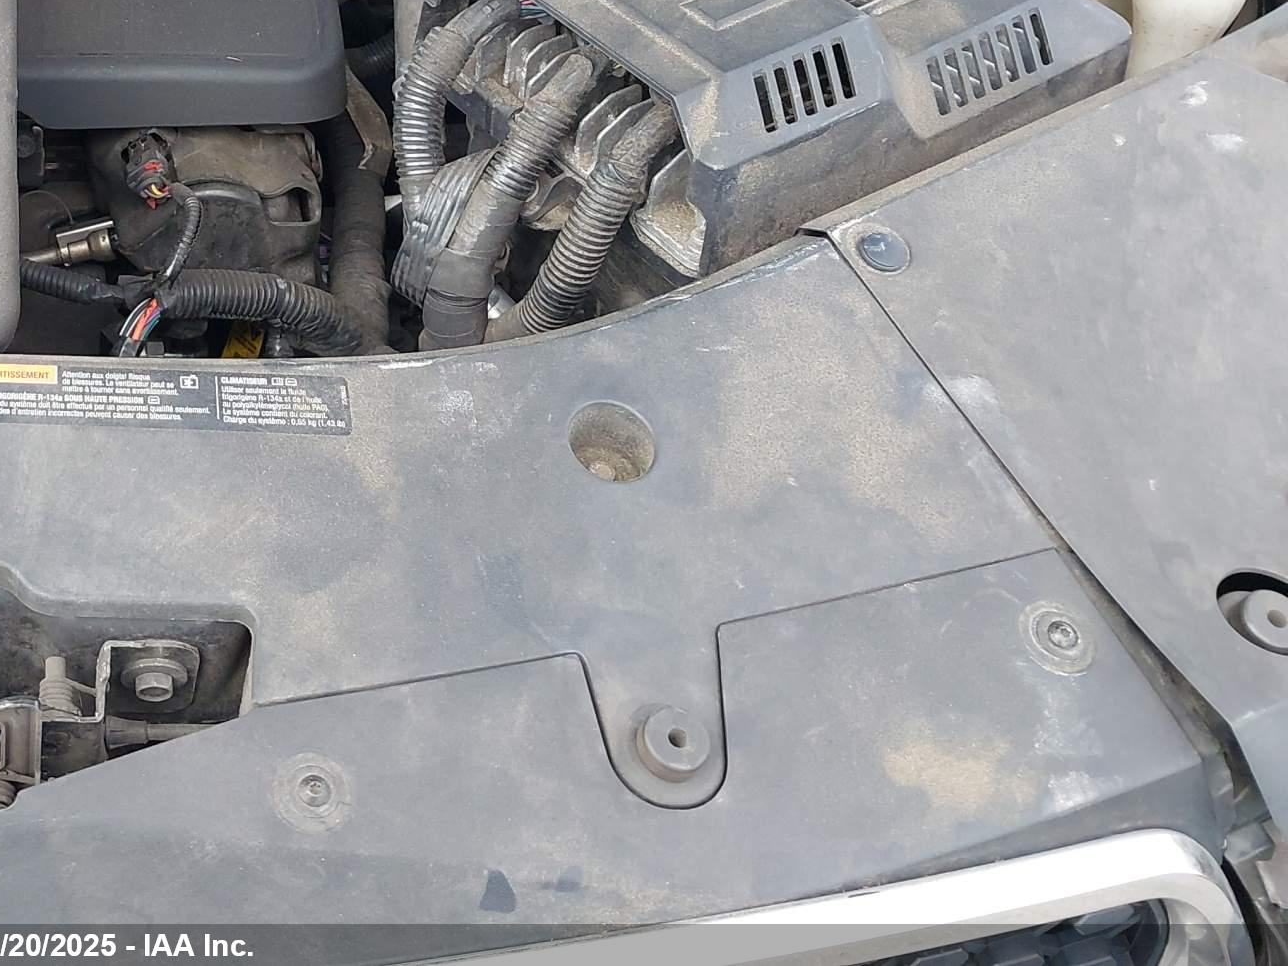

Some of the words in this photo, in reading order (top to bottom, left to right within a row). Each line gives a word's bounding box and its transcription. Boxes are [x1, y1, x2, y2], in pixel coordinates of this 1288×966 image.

[221, 377, 268, 385] CLIMATISEUR
[245, 386, 279, 394] seulement
[64, 394, 83, 402] SOUS
[84, 394, 108, 403] HAUTE
[11, 408, 47, 416] d'entretien
[175, 406, 211, 414] seulement.
[290, 410, 298, 418] du
[299, 411, 328, 419] colorant.
